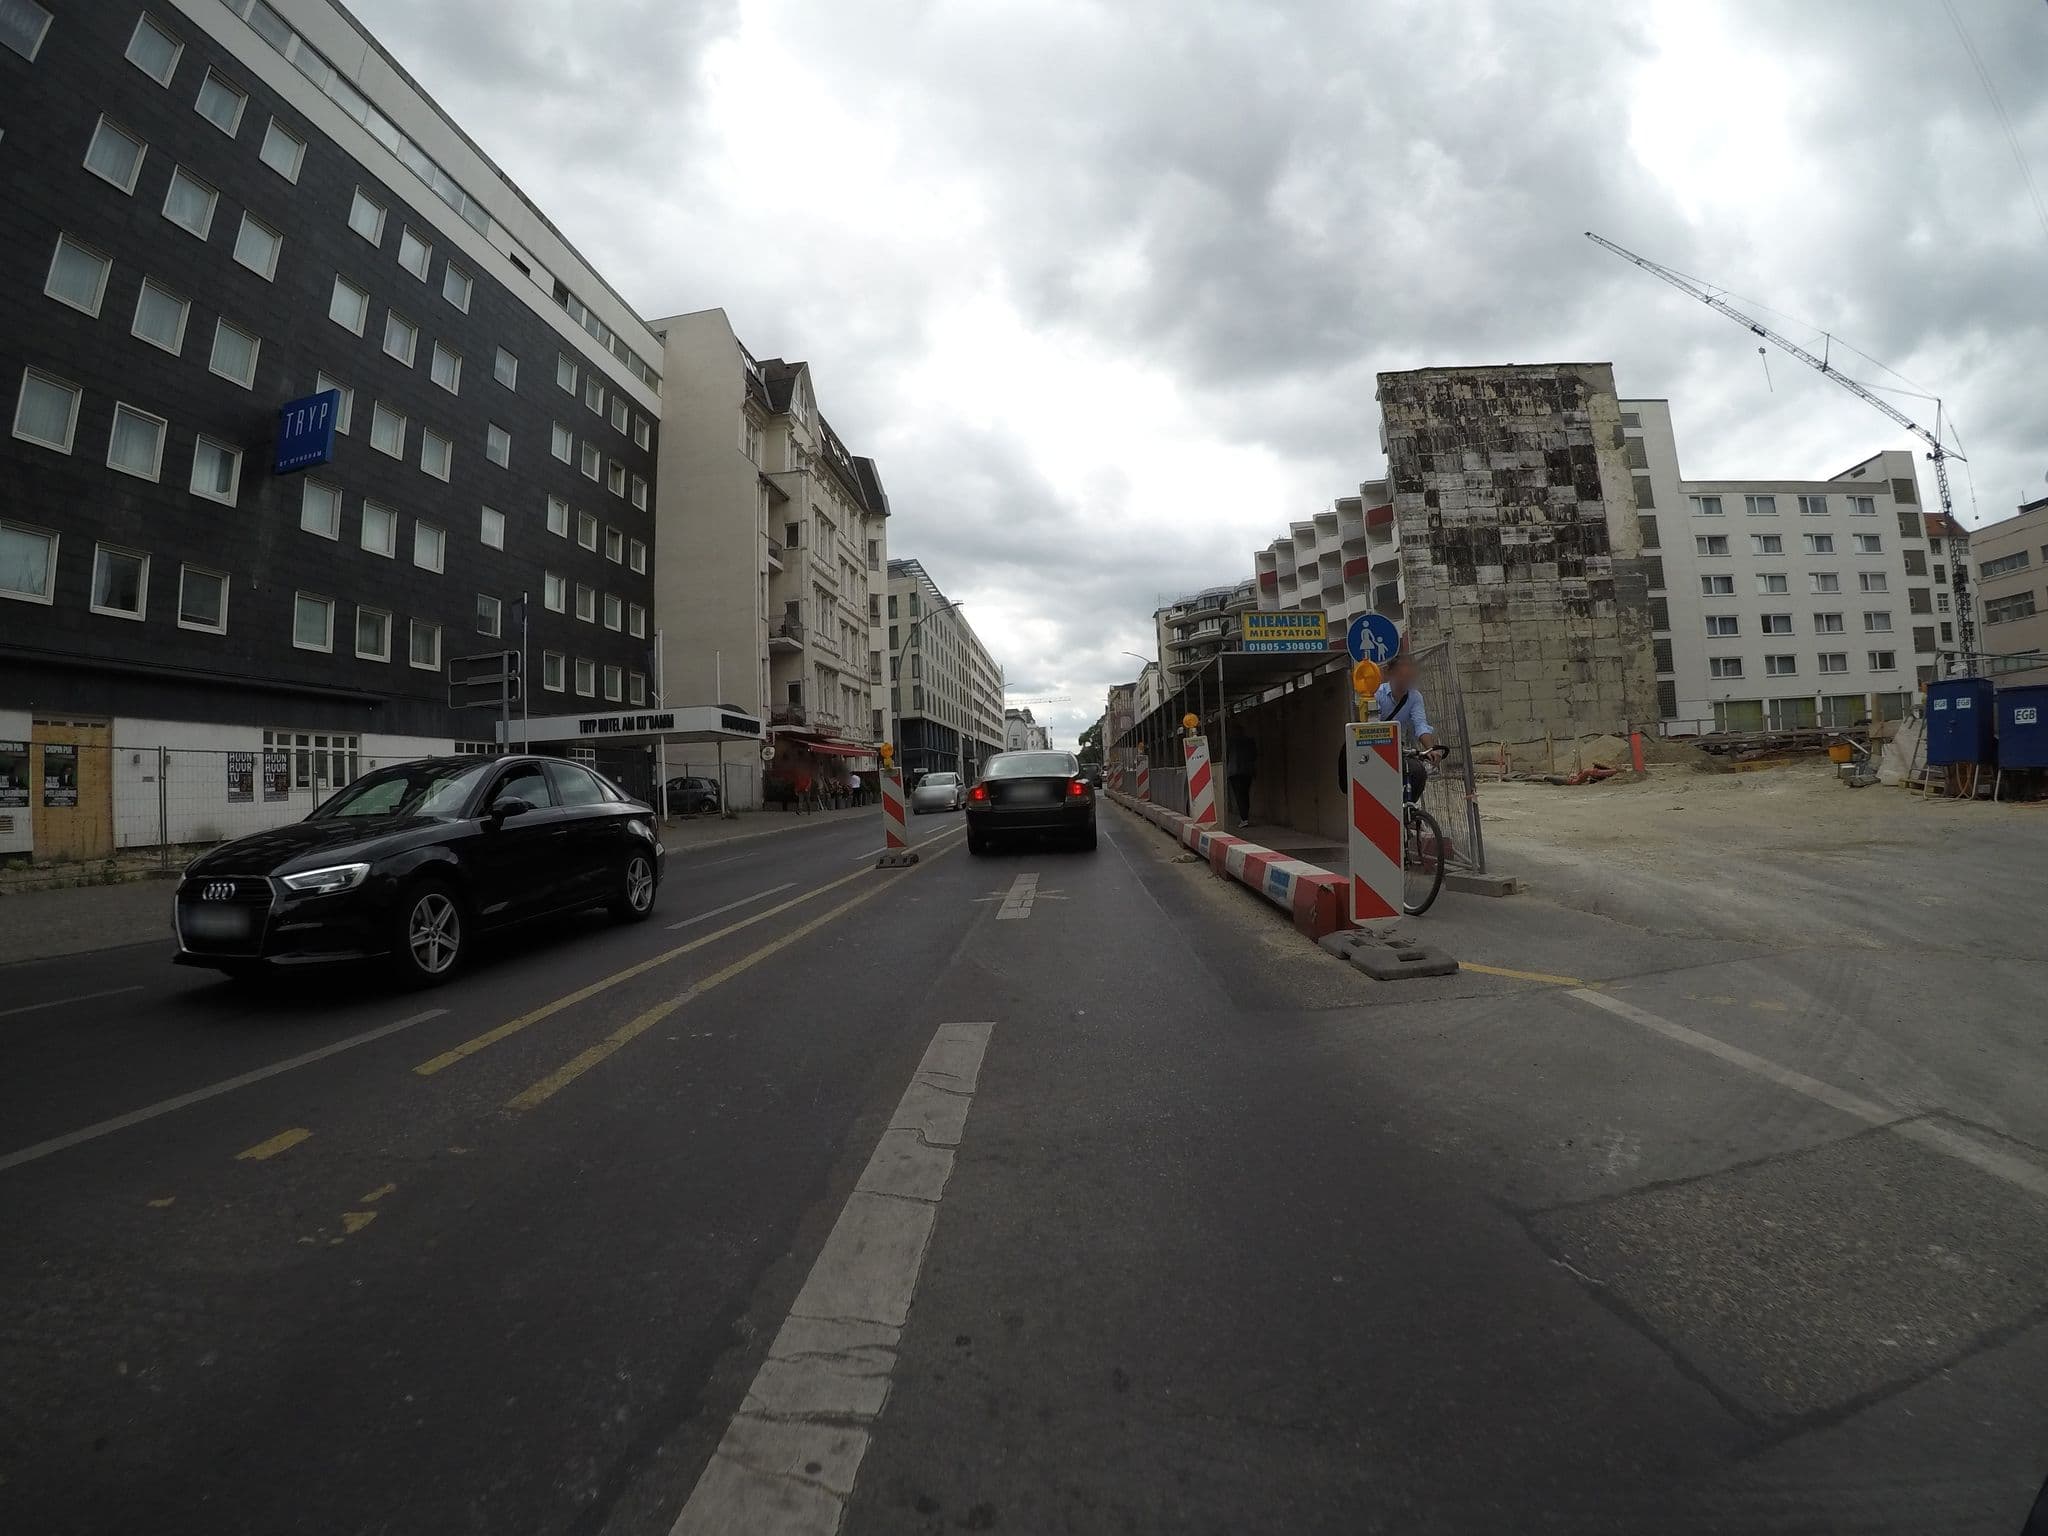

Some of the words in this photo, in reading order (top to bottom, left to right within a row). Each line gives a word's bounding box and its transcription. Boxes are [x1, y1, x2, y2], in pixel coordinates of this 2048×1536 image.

[286, 402, 329, 439] TRYP
[1248, 615, 1321, 627] NIEMEIER
[1250, 629, 1321, 637] MIETSTATION
[2015, 709, 2035, 721] EGB
[579, 719, 597, 734] TRYP
[598, 717, 620, 733] HOTEL
[622, 716, 635, 731] AM
[229, 762, 252, 772] HUUR
[265, 763, 287, 772] HUUR
[229, 773, 239, 782] TU
[265, 773, 275, 782] TU
